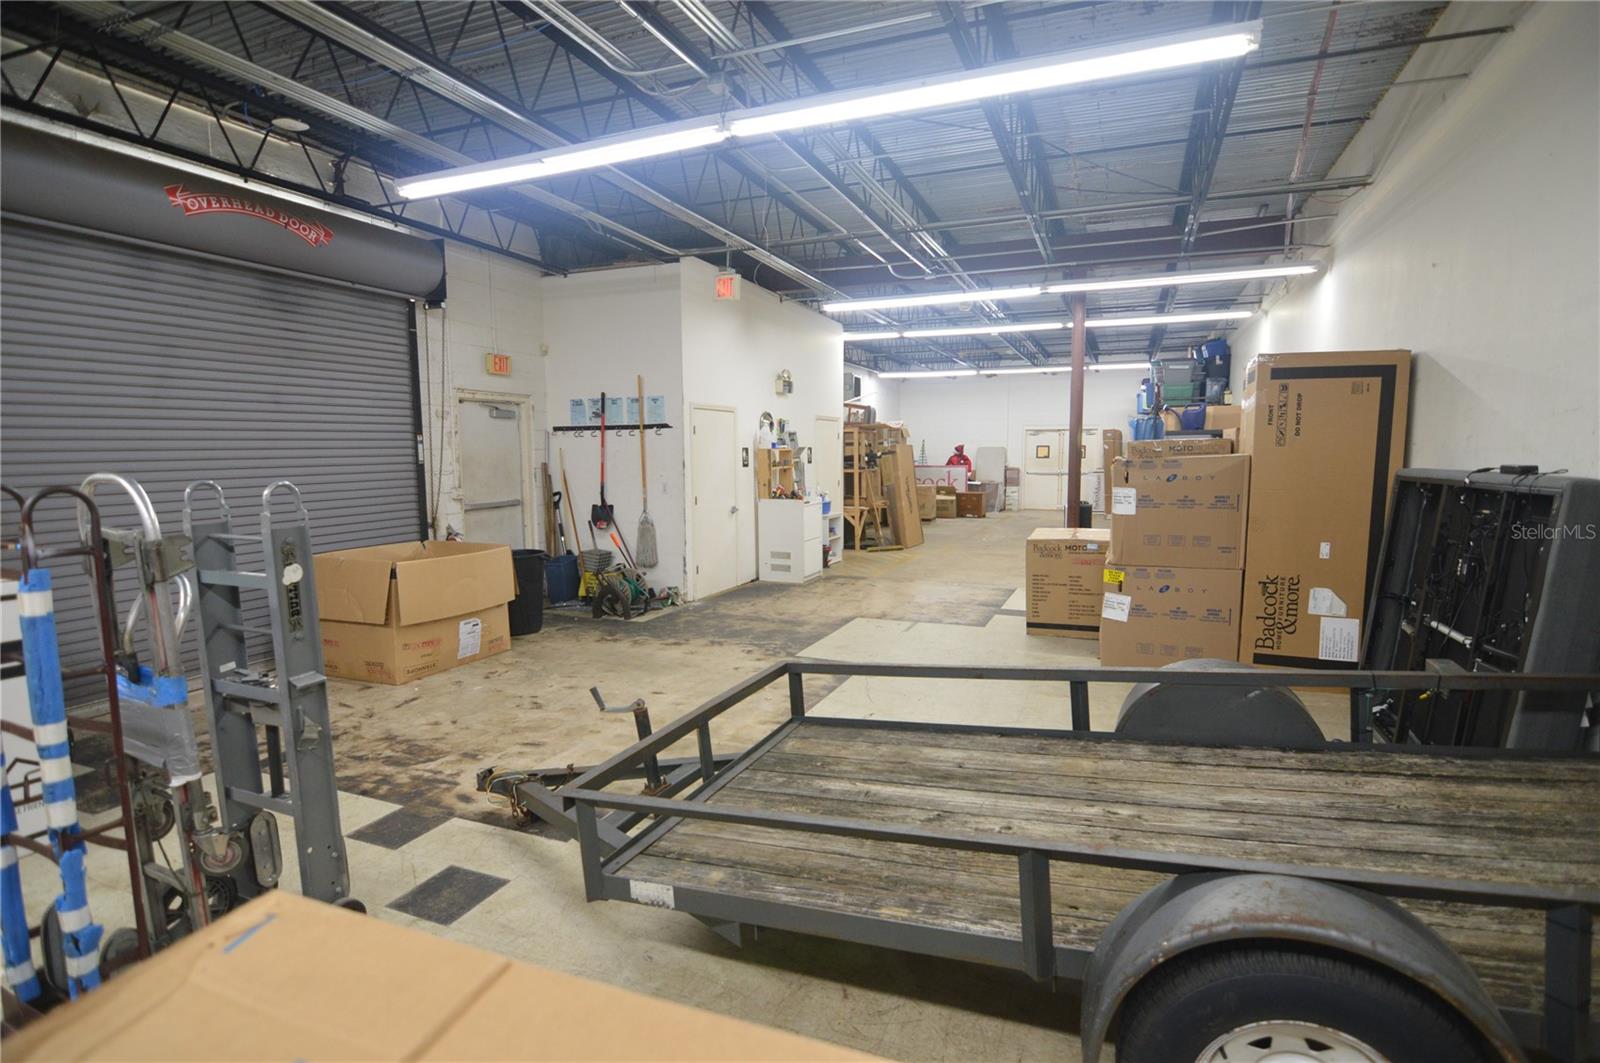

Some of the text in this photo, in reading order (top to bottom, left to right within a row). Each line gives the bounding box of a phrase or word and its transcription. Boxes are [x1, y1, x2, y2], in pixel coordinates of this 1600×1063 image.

[187, 196, 318, 242] OVERHEAD DOOR
[1254, 574, 1280, 651] Badcock
[1278, 576, 1287, 622] FURNITURE
